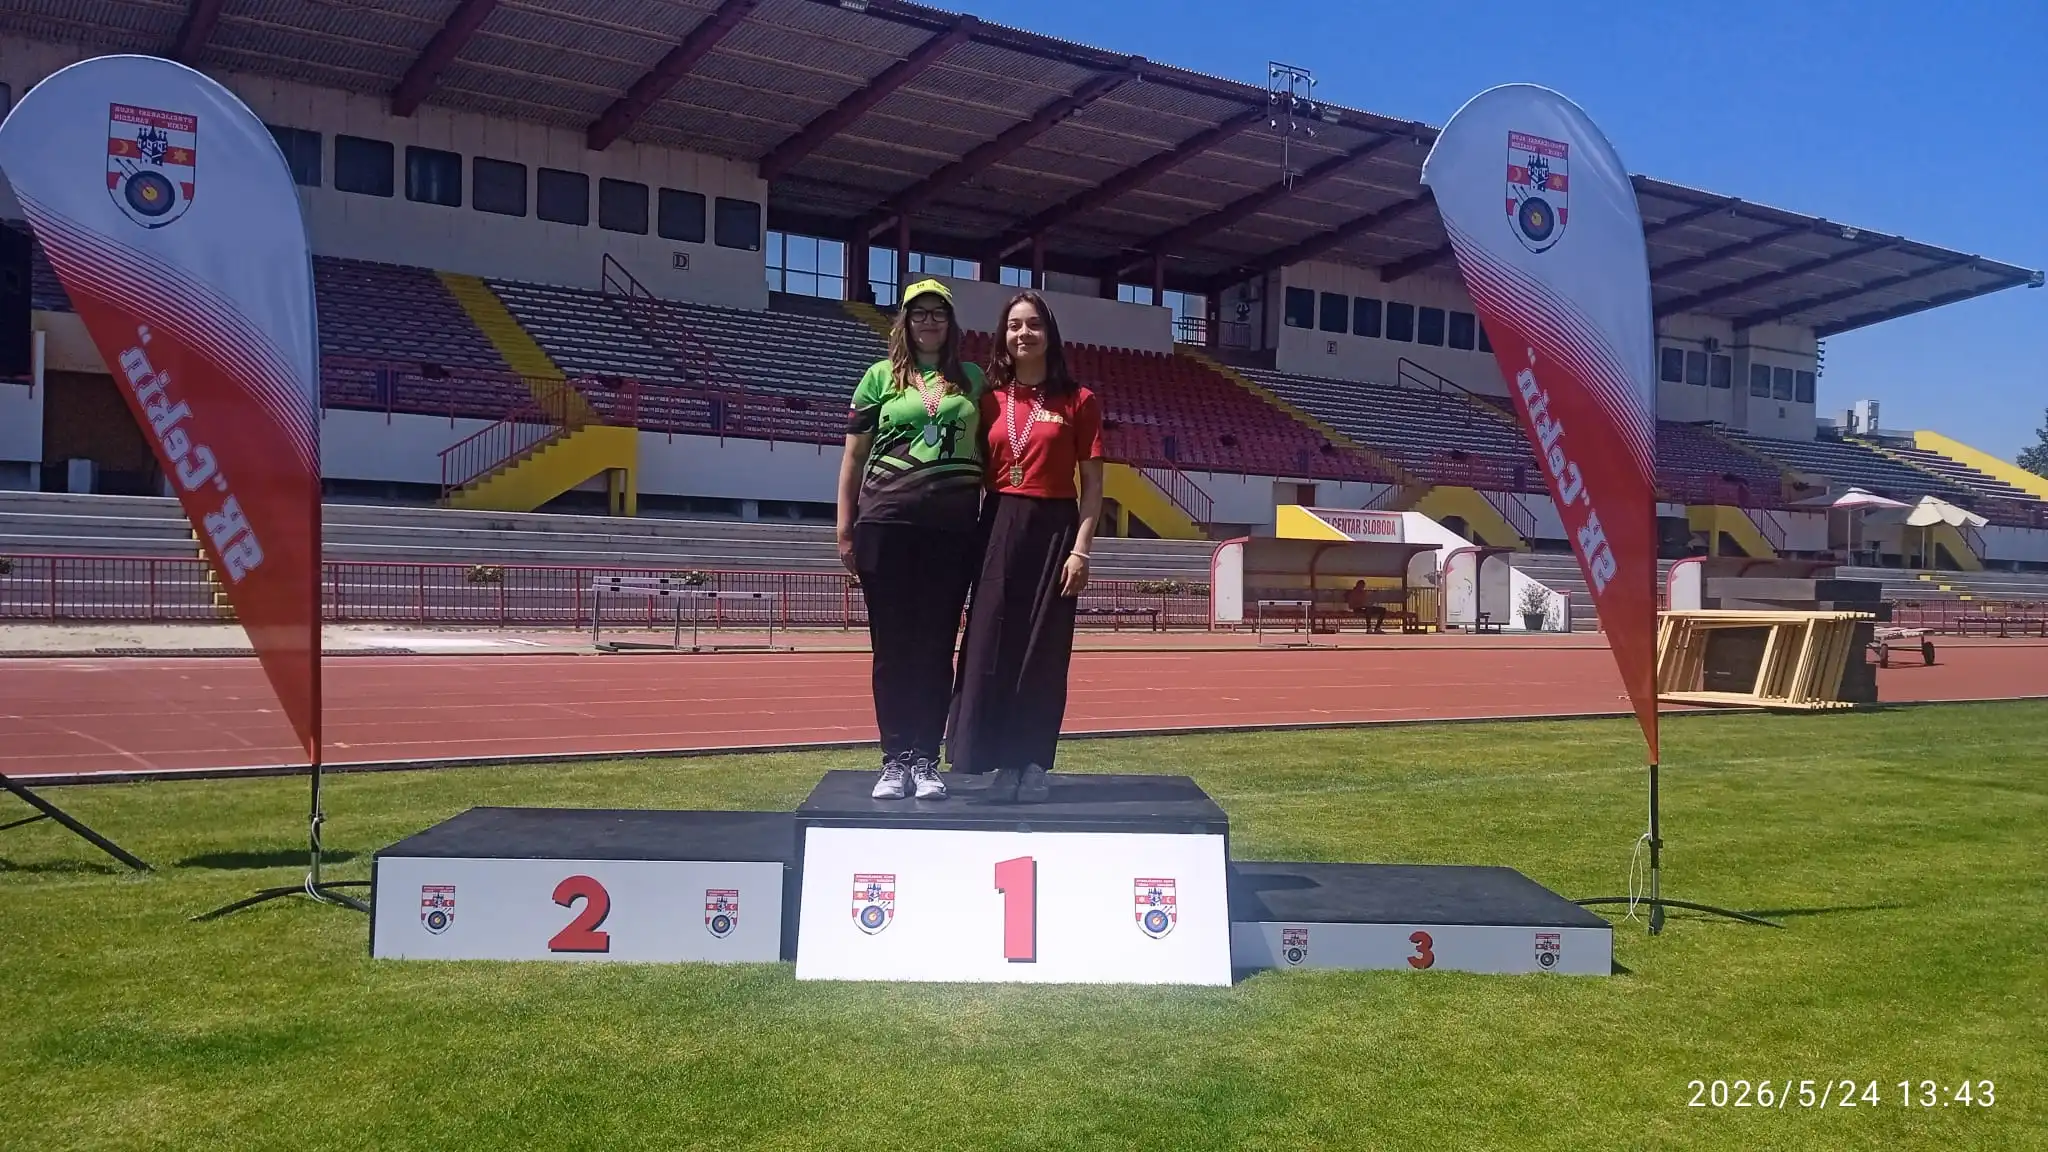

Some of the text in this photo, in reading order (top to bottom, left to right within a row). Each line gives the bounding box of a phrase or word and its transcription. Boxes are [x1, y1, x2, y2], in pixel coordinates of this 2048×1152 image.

[675, 254, 688, 268] D
[1332, 518, 1361, 535] CENTAR
[1363, 519, 1396, 536] SLOBODA
[547, 874, 610, 954] 2
[994, 856, 1037, 963] 1
[1407, 930, 1435, 970] 3
